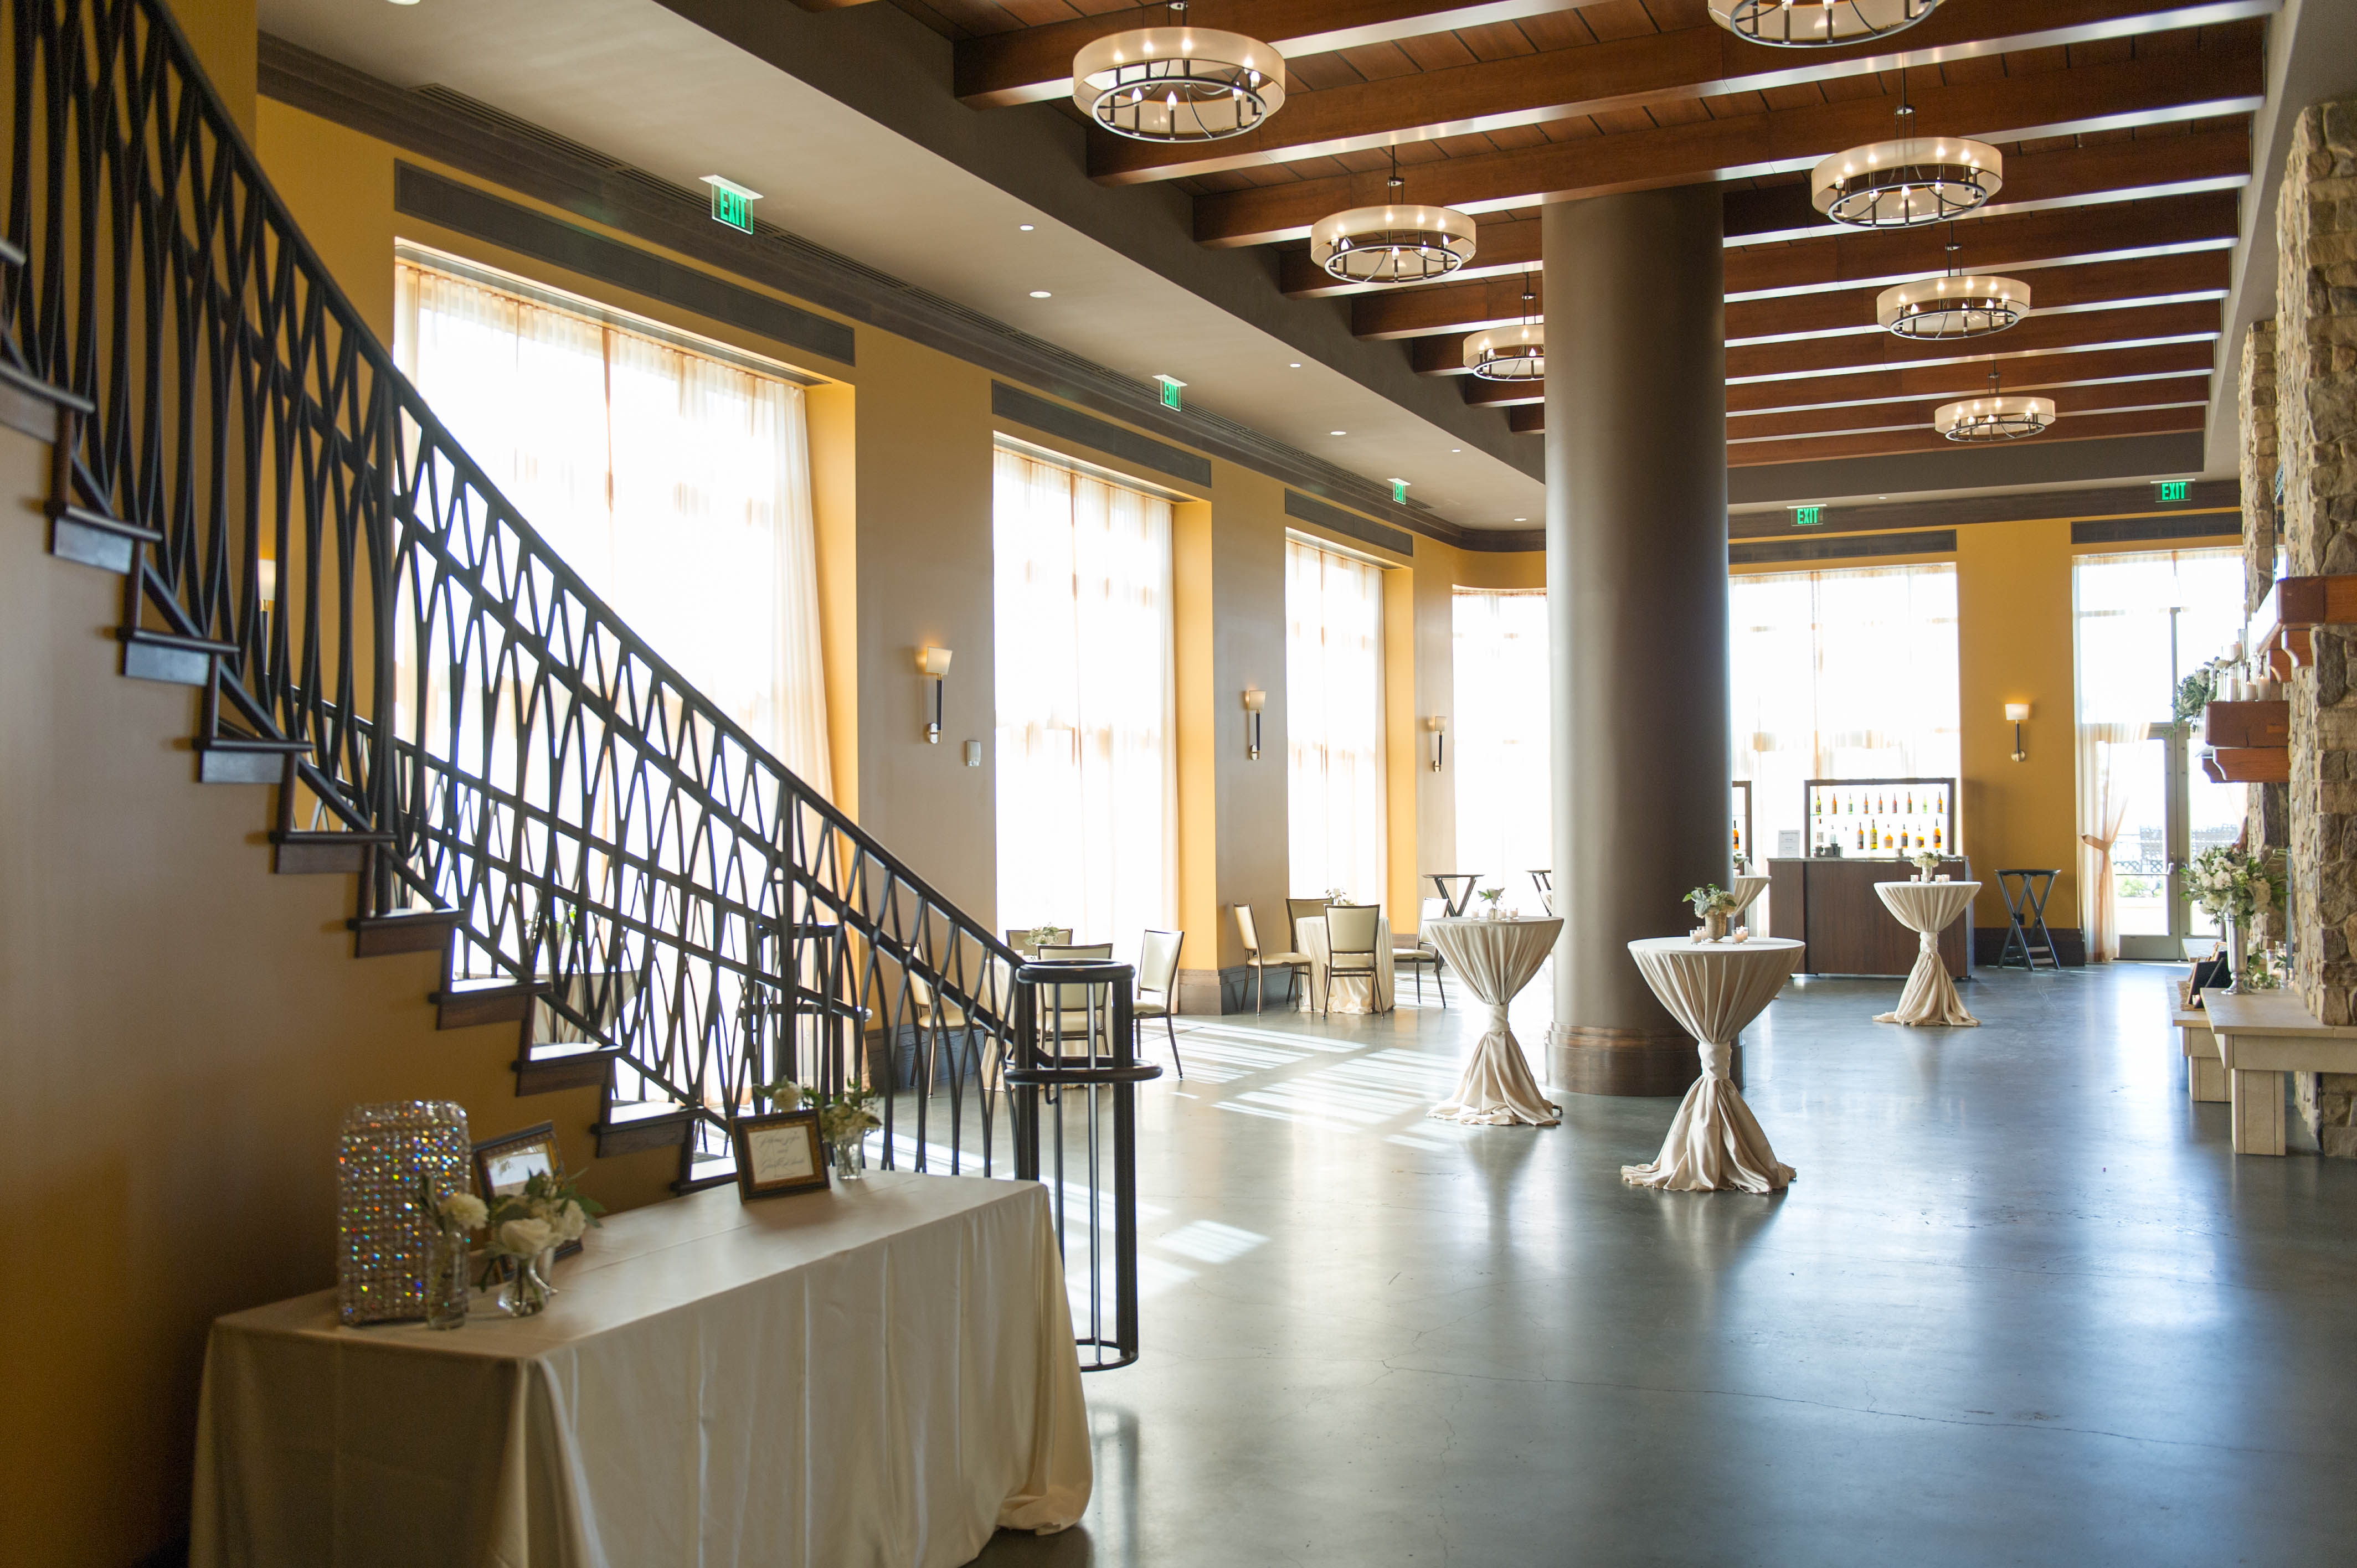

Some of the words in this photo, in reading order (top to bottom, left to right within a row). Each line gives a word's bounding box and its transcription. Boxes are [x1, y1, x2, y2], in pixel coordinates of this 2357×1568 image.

[720, 187, 747, 228] EXIT
[1164, 381, 1177, 408] EXIT
[2162, 482, 2186, 501] EXIT
[1797, 507, 1819, 524] EXIT
